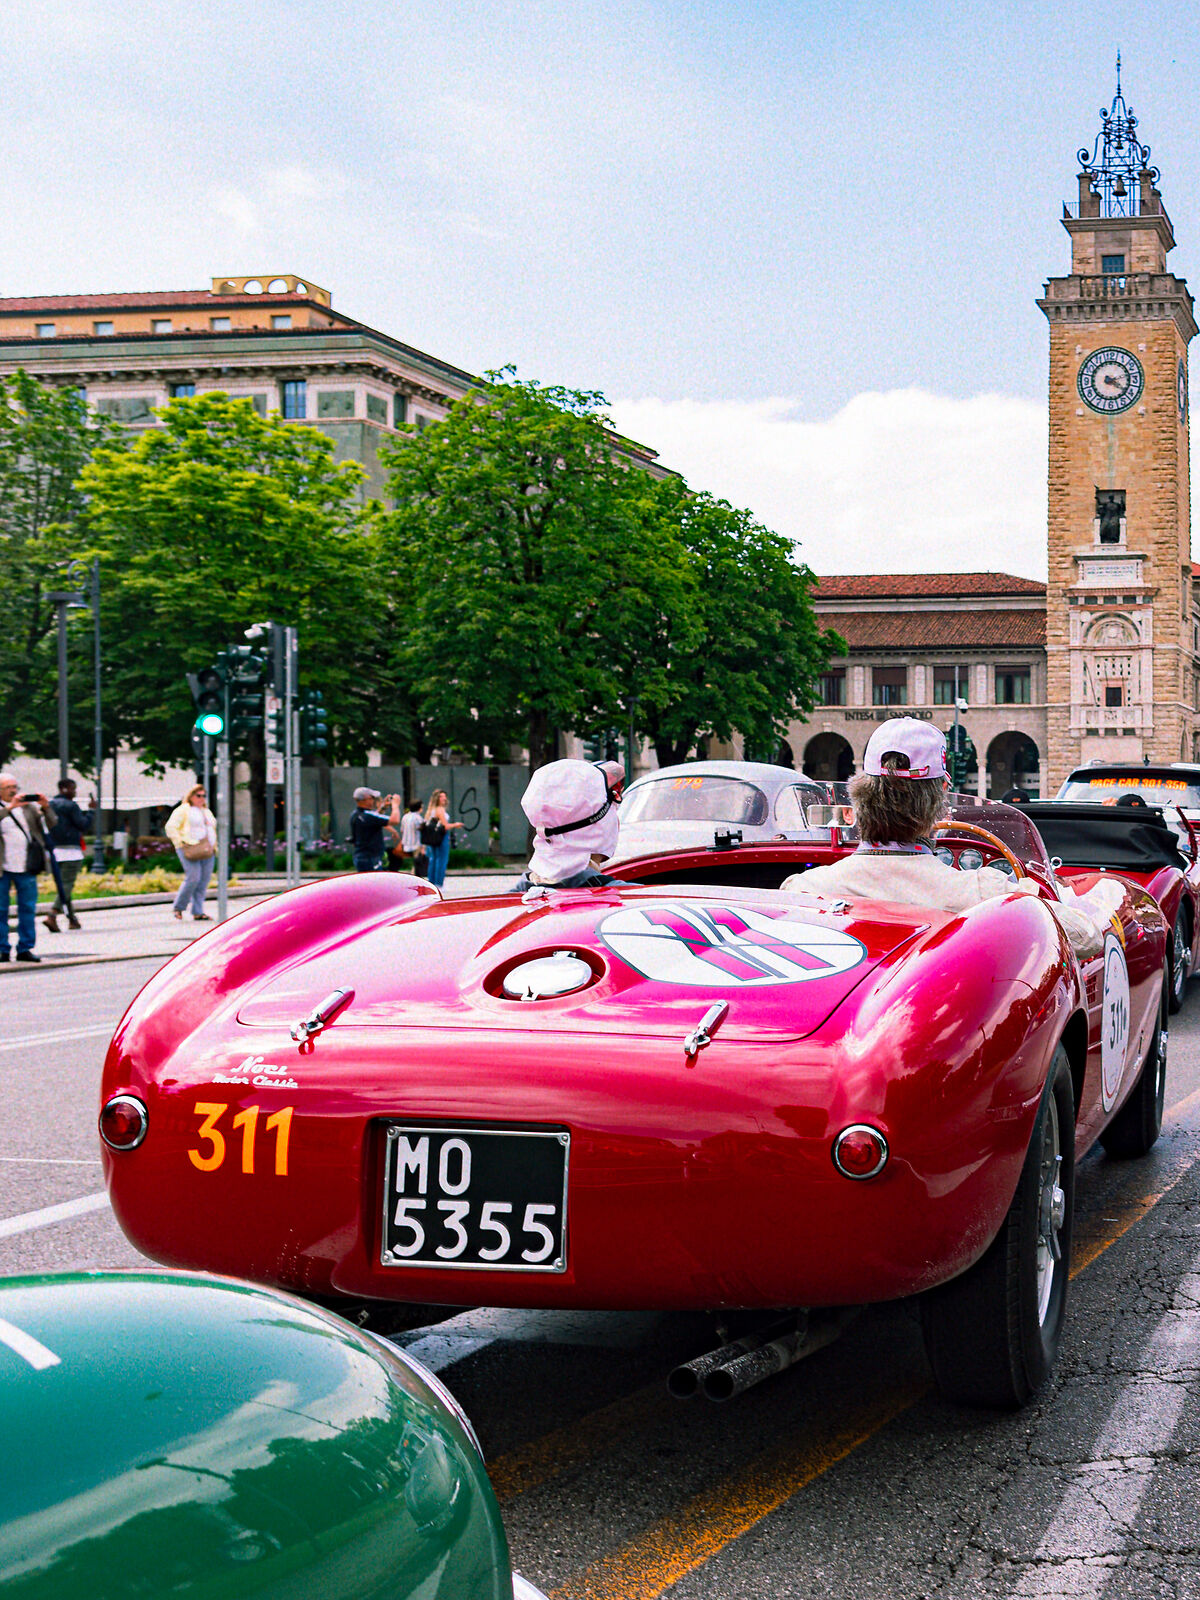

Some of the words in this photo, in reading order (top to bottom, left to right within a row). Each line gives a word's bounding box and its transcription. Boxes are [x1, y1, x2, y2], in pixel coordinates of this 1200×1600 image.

[844, 712, 874, 720] INTESA
[1090, 778, 1117, 788] PACE
[1118, 778, 1140, 788] CAR
[1141, 778, 1188, 791] 301-350
[188, 1102, 294, 1176] 311
[396, 1136, 472, 1196] MO
[392, 1198, 556, 1262] 5355
